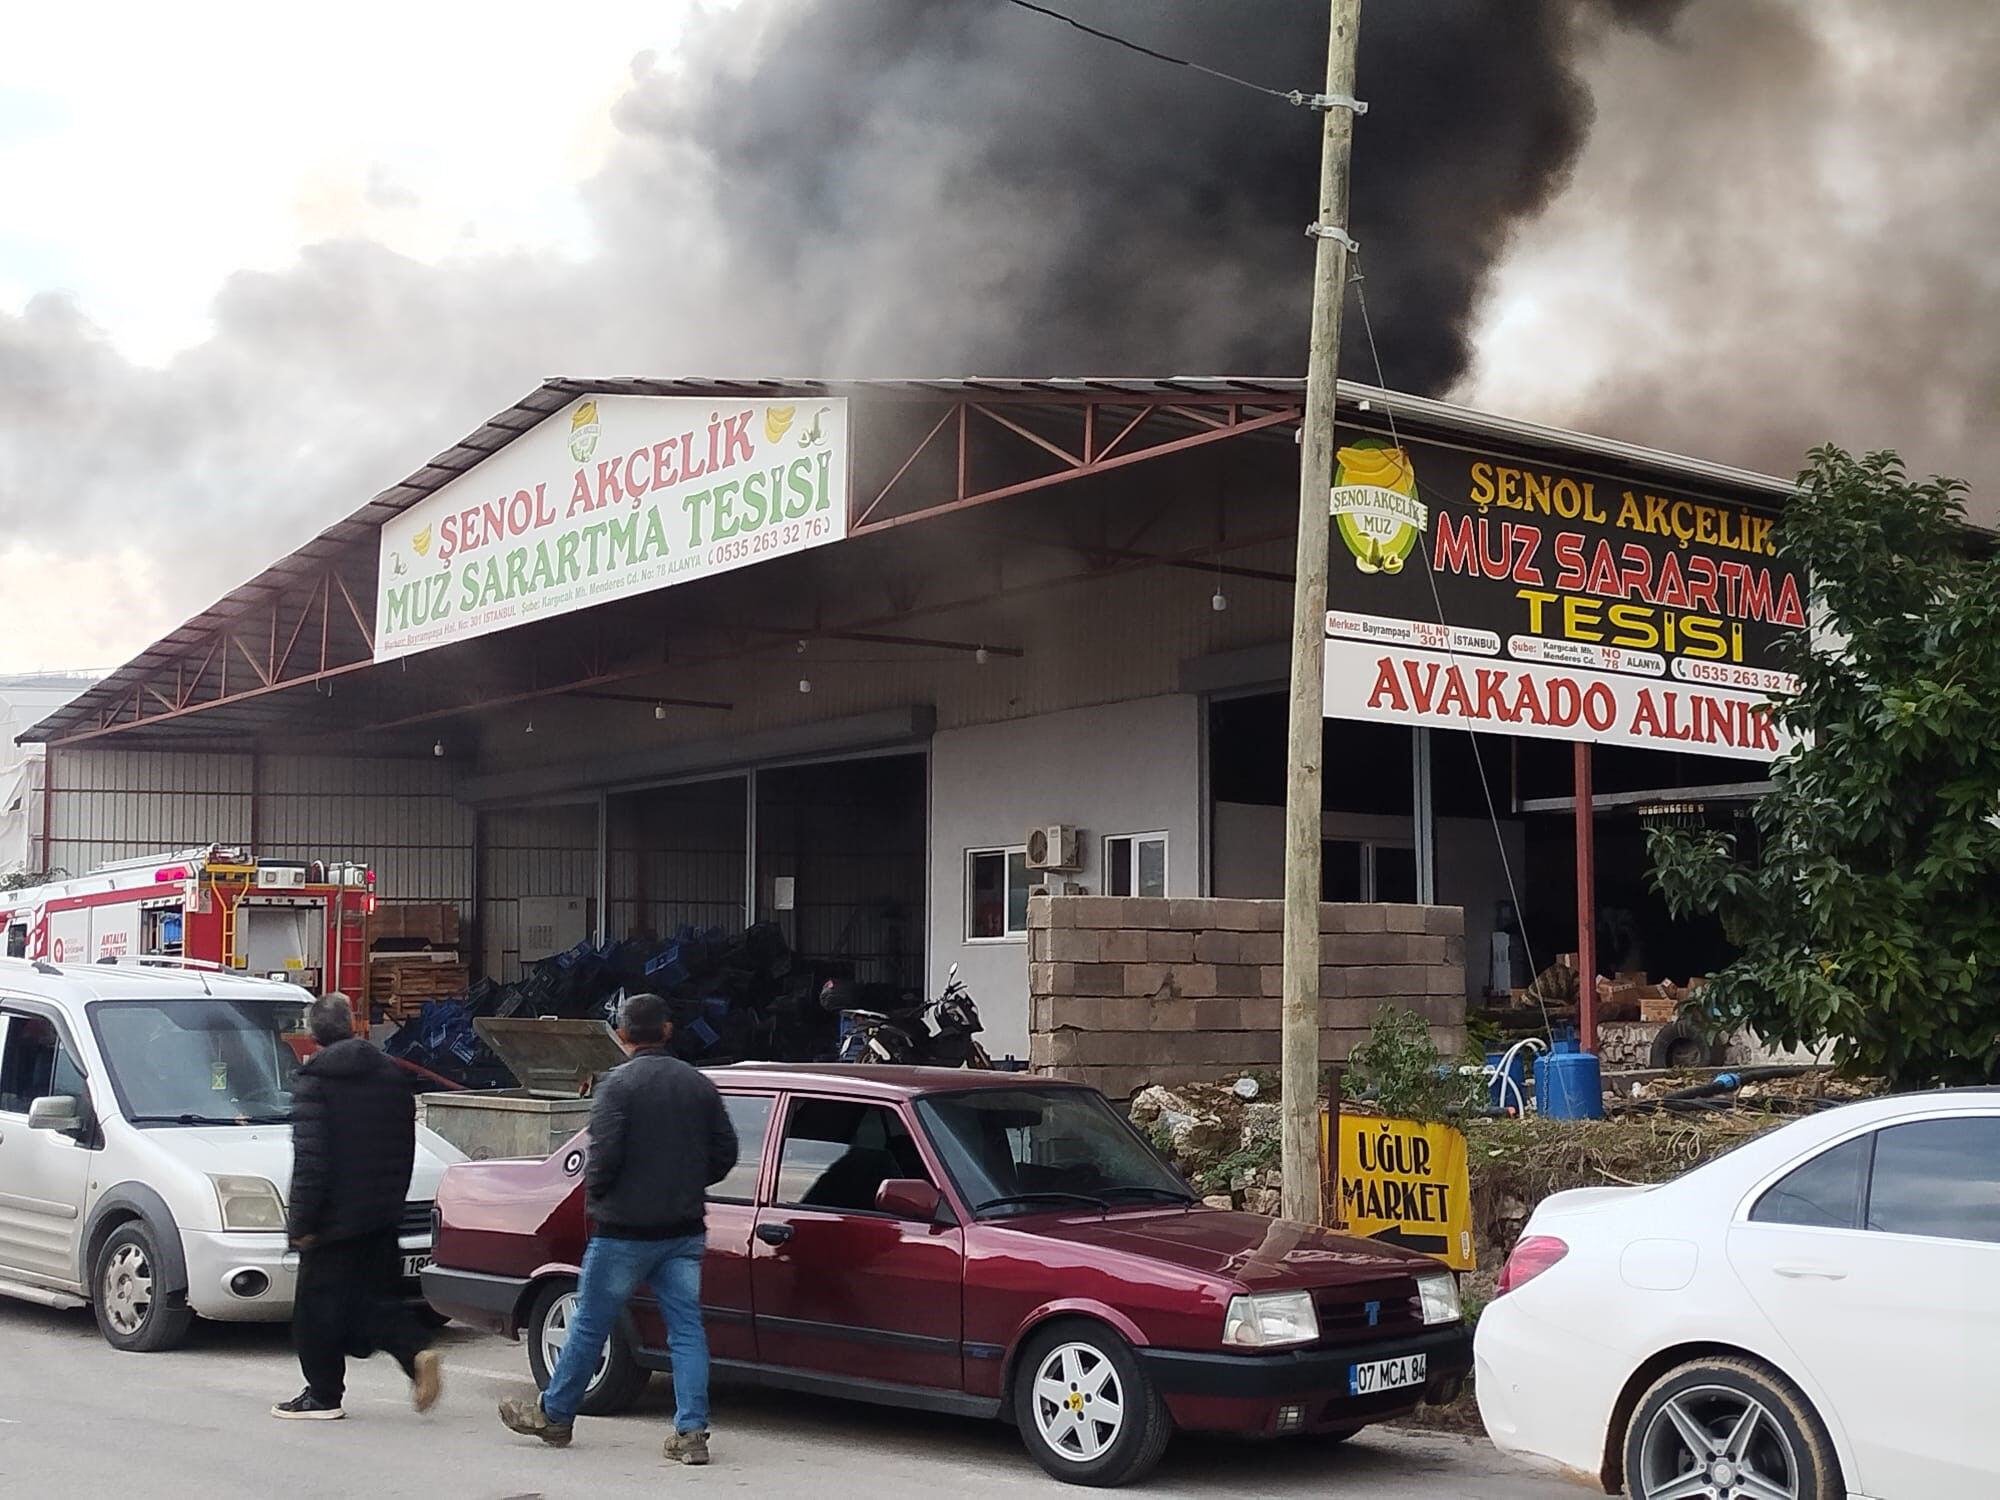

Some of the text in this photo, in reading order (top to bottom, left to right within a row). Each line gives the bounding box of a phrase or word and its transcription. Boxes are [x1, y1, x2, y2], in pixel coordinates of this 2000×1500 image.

[438, 411, 755, 569] ŞENOL AKÇELİK
[1334, 489, 1419, 519] ŞENOL AKÇELİK
[1469, 462, 1776, 556] ŞENOL AKÇELİK
[1363, 515, 1392, 534] MUZ
[385, 449, 833, 634] MUZ SARARTMA TESİSİ
[716, 518, 822, 564] 0535 263 32 76
[668, 555, 701, 575] ALANYA
[1433, 511, 1806, 628] MUZ SARARTMA
[1329, 617, 1450, 643] Merkez: Bayrampaşa HAL NO
[1516, 589, 1744, 662] TESİSİ
[1420, 635, 1444, 647] 301
[1454, 632, 1498, 650] İSTANBUL
[1511, 640, 1537, 655] Şube:
[1601, 648, 1621, 660] NO
[1543, 652, 1596, 665] Menderes Cd.
[1604, 659, 1620, 670] 78
[1626, 657, 1661, 671] ALANYA
[1692, 664, 1728, 682] 0535
[1733, 670, 1759, 687] 263
[1763, 674, 1780, 689] 32
[1367, 657, 1617, 732] AVAKADO
[1358, 1122, 1431, 1176] UĞUR
[1342, 1177, 1449, 1222] MARKET
[1359, 1365, 1375, 1391] 07
[1380, 1360, 1407, 1388] MCA
[1411, 1356, 1425, 1382] 84
